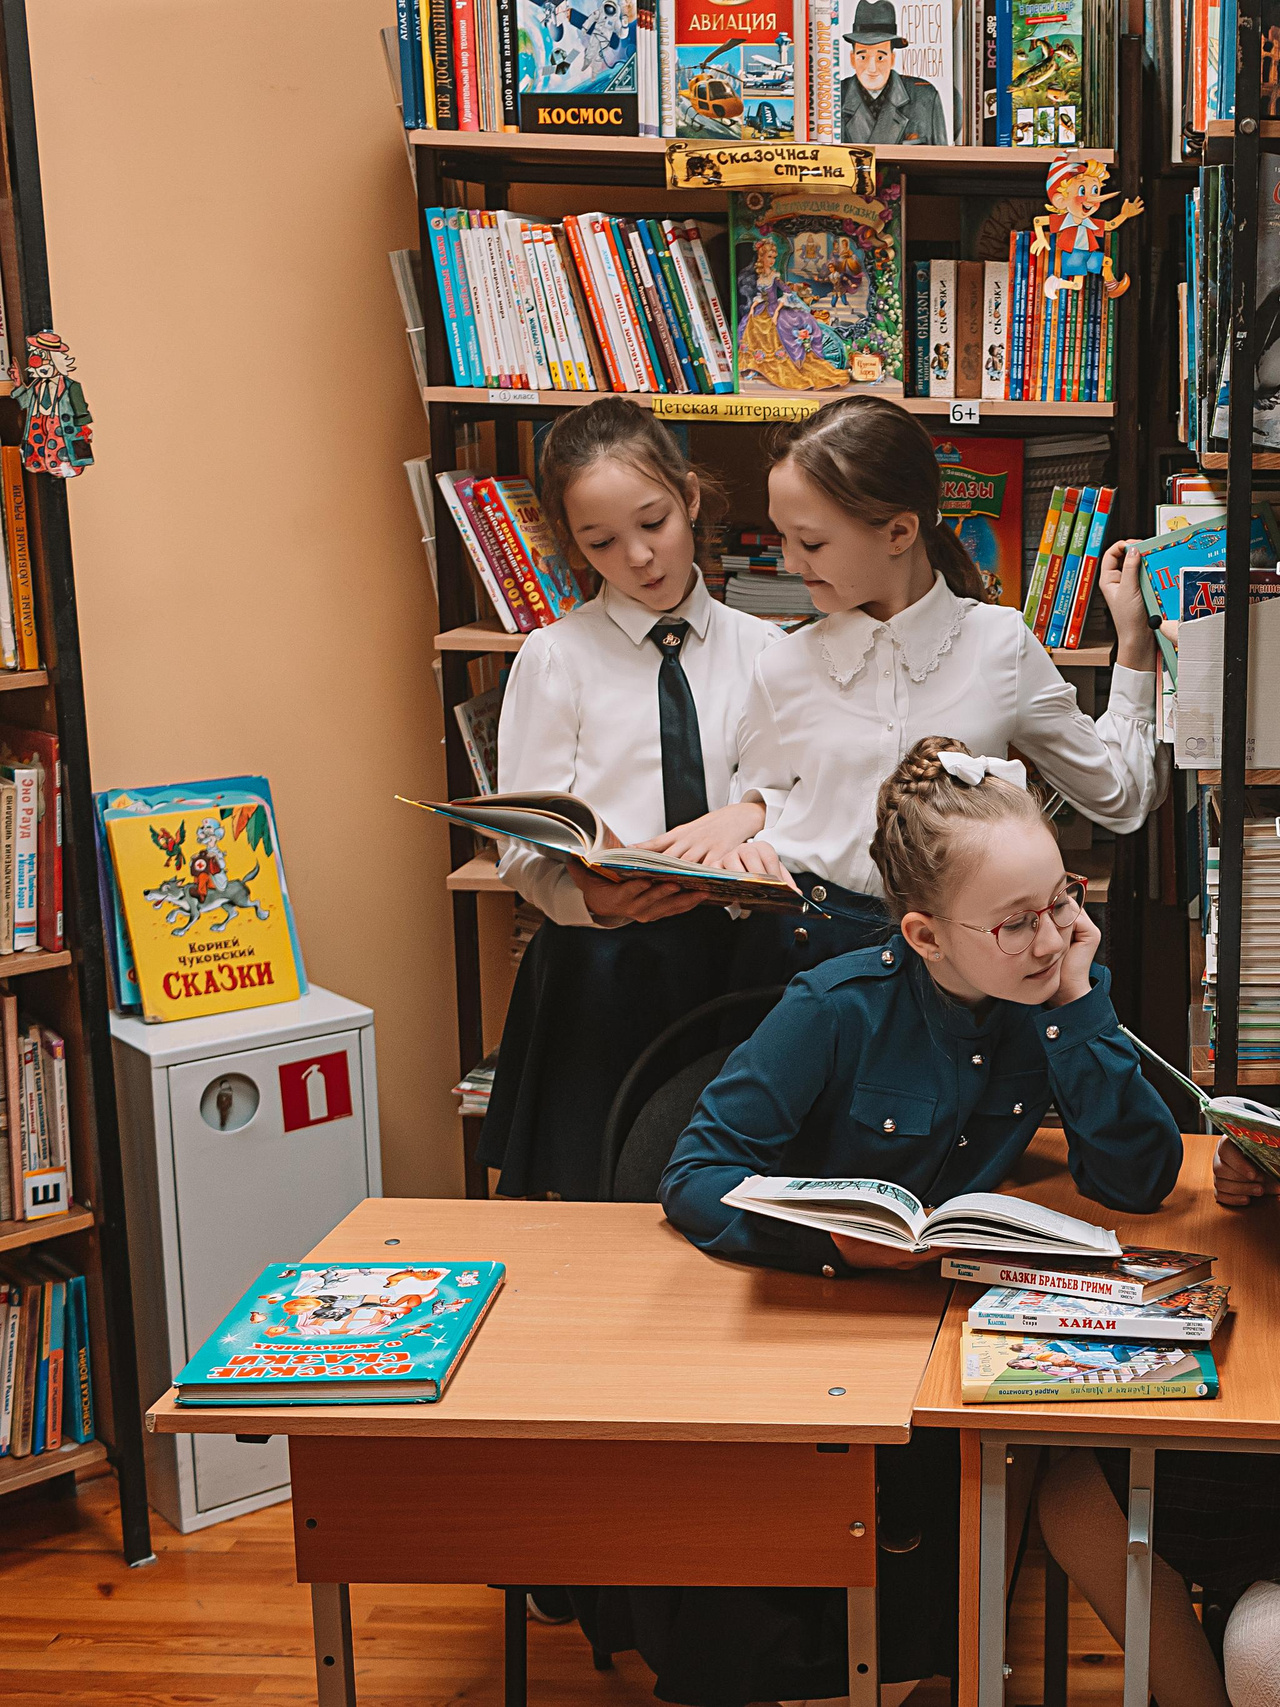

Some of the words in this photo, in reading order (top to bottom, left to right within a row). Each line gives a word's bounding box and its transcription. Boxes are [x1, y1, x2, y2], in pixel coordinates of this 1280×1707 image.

[398, 11, 408, 40] АТЛАС
[458, 19, 467, 49] техники
[501, 14, 510, 55] планеты
[688, 13, 776, 34] АВИАЦИЯ
[816, 20, 830, 53] МИР
[902, 4, 942, 44] СЕРГЕЯ
[460, 51, 469, 66] мир
[503, 60, 511, 84] тайн
[902, 48, 944, 78] КОРОЛЁВА
[460, 68, 472, 122] Удивительный
[504, 88, 513, 110] 1000
[816, 57, 830, 119] ПОЗНАЮ
[438, 93, 451, 117] ВСЕ
[538, 108, 622, 125] КОСМОС
[766, 105, 776, 124] NAVY
[817, 124, 832, 134] Я
[716, 148, 820, 166] Сказочная
[774, 163, 845, 182] страна
[436, 234, 448, 265] СКАЗКИ
[485, 237, 497, 266] Сказки
[442, 268, 457, 319] ВОЛШЕБНЫЕ
[613, 292, 627, 323] ЧТЕНИЕ
[709, 297, 724, 328] ЧТЕНИЕ
[917, 291, 928, 338] СКАЗОК
[623, 326, 645, 385] ВНЕКЛАССНОЕ
[652, 398, 718, 416] Детская
[720, 402, 818, 422] литература
[952, 404, 976, 422] 6+
[11, 483, 23, 521] БАСНИ
[476, 509, 502, 556] ДЕВОЧЕК
[482, 503, 506, 541] ИСТОРИЙ
[15, 526, 28, 588] ЛЮБИМЫЕ
[500, 541, 525, 583] СМЕШНЫХ
[501, 576, 524, 609] 100
[521, 579, 545, 613] 100
[21, 594, 33, 636] САМЫЕ
[20, 778, 33, 802] Эно
[18, 807, 33, 839] Рауд
[17, 859, 25, 884] Моховая
[16, 886, 25, 908] Борода
[27, 875, 35, 908] Полботинка
[1000, 1269, 1037, 1286] СКАЗКИ
[1038, 1272, 1079, 1293] БРАТЬЕВ
[1080, 1280, 1112, 1296] ГРИММ
[1058, 1316, 1116, 1330] ХАЙДИ
[228, 1352, 410, 1366] СКАЗКИ
[248, 1341, 380, 1350] ЖИВОТНЫХ
[384, 1340, 403, 1349] О
[77, 1346, 88, 1380] ВОЙНА
[206, 1362, 415, 1379] РУССКИЕ
[1034, 1387, 1059, 1395] Андрей
[1069, 1385, 1104, 1395] Машуня
[79, 1383, 91, 1434] ТРОЯНСКАЯ
